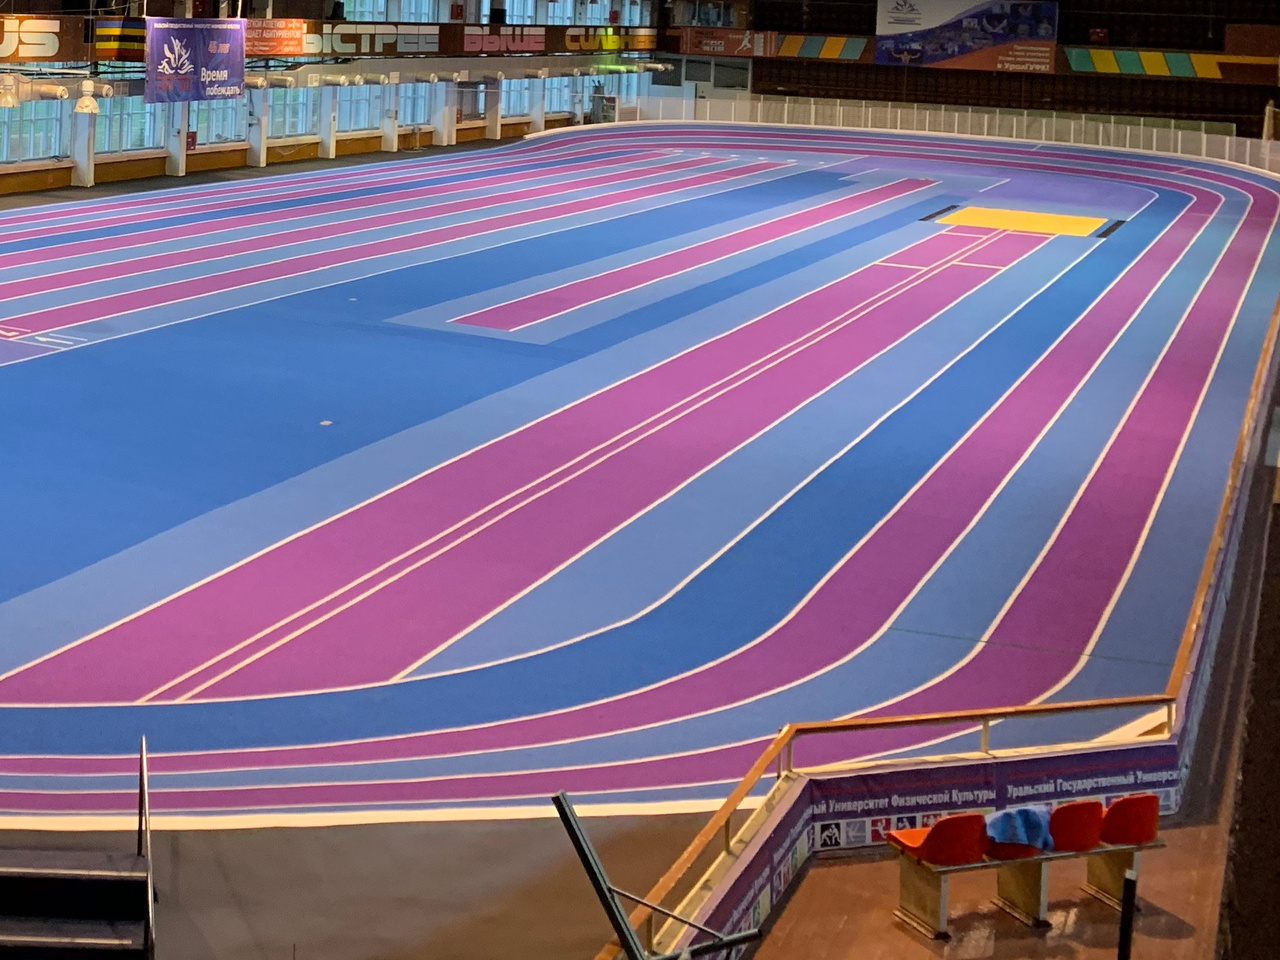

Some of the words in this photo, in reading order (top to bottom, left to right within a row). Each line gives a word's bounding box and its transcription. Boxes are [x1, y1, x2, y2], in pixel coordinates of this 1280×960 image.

[302, 23, 439, 53] ЫСТРЕЕ
[464, 26, 545, 52] ВЫШЕ
[200, 67, 228, 84] Время
[34, 335, 73, 345] 1
[1007, 779, 1055, 799] Уральский
[1057, 771, 1134, 793] Государственный
[829, 797, 889, 813] Университет
[891, 790, 950, 808] Физической
[951, 788, 997, 806] Культуры
